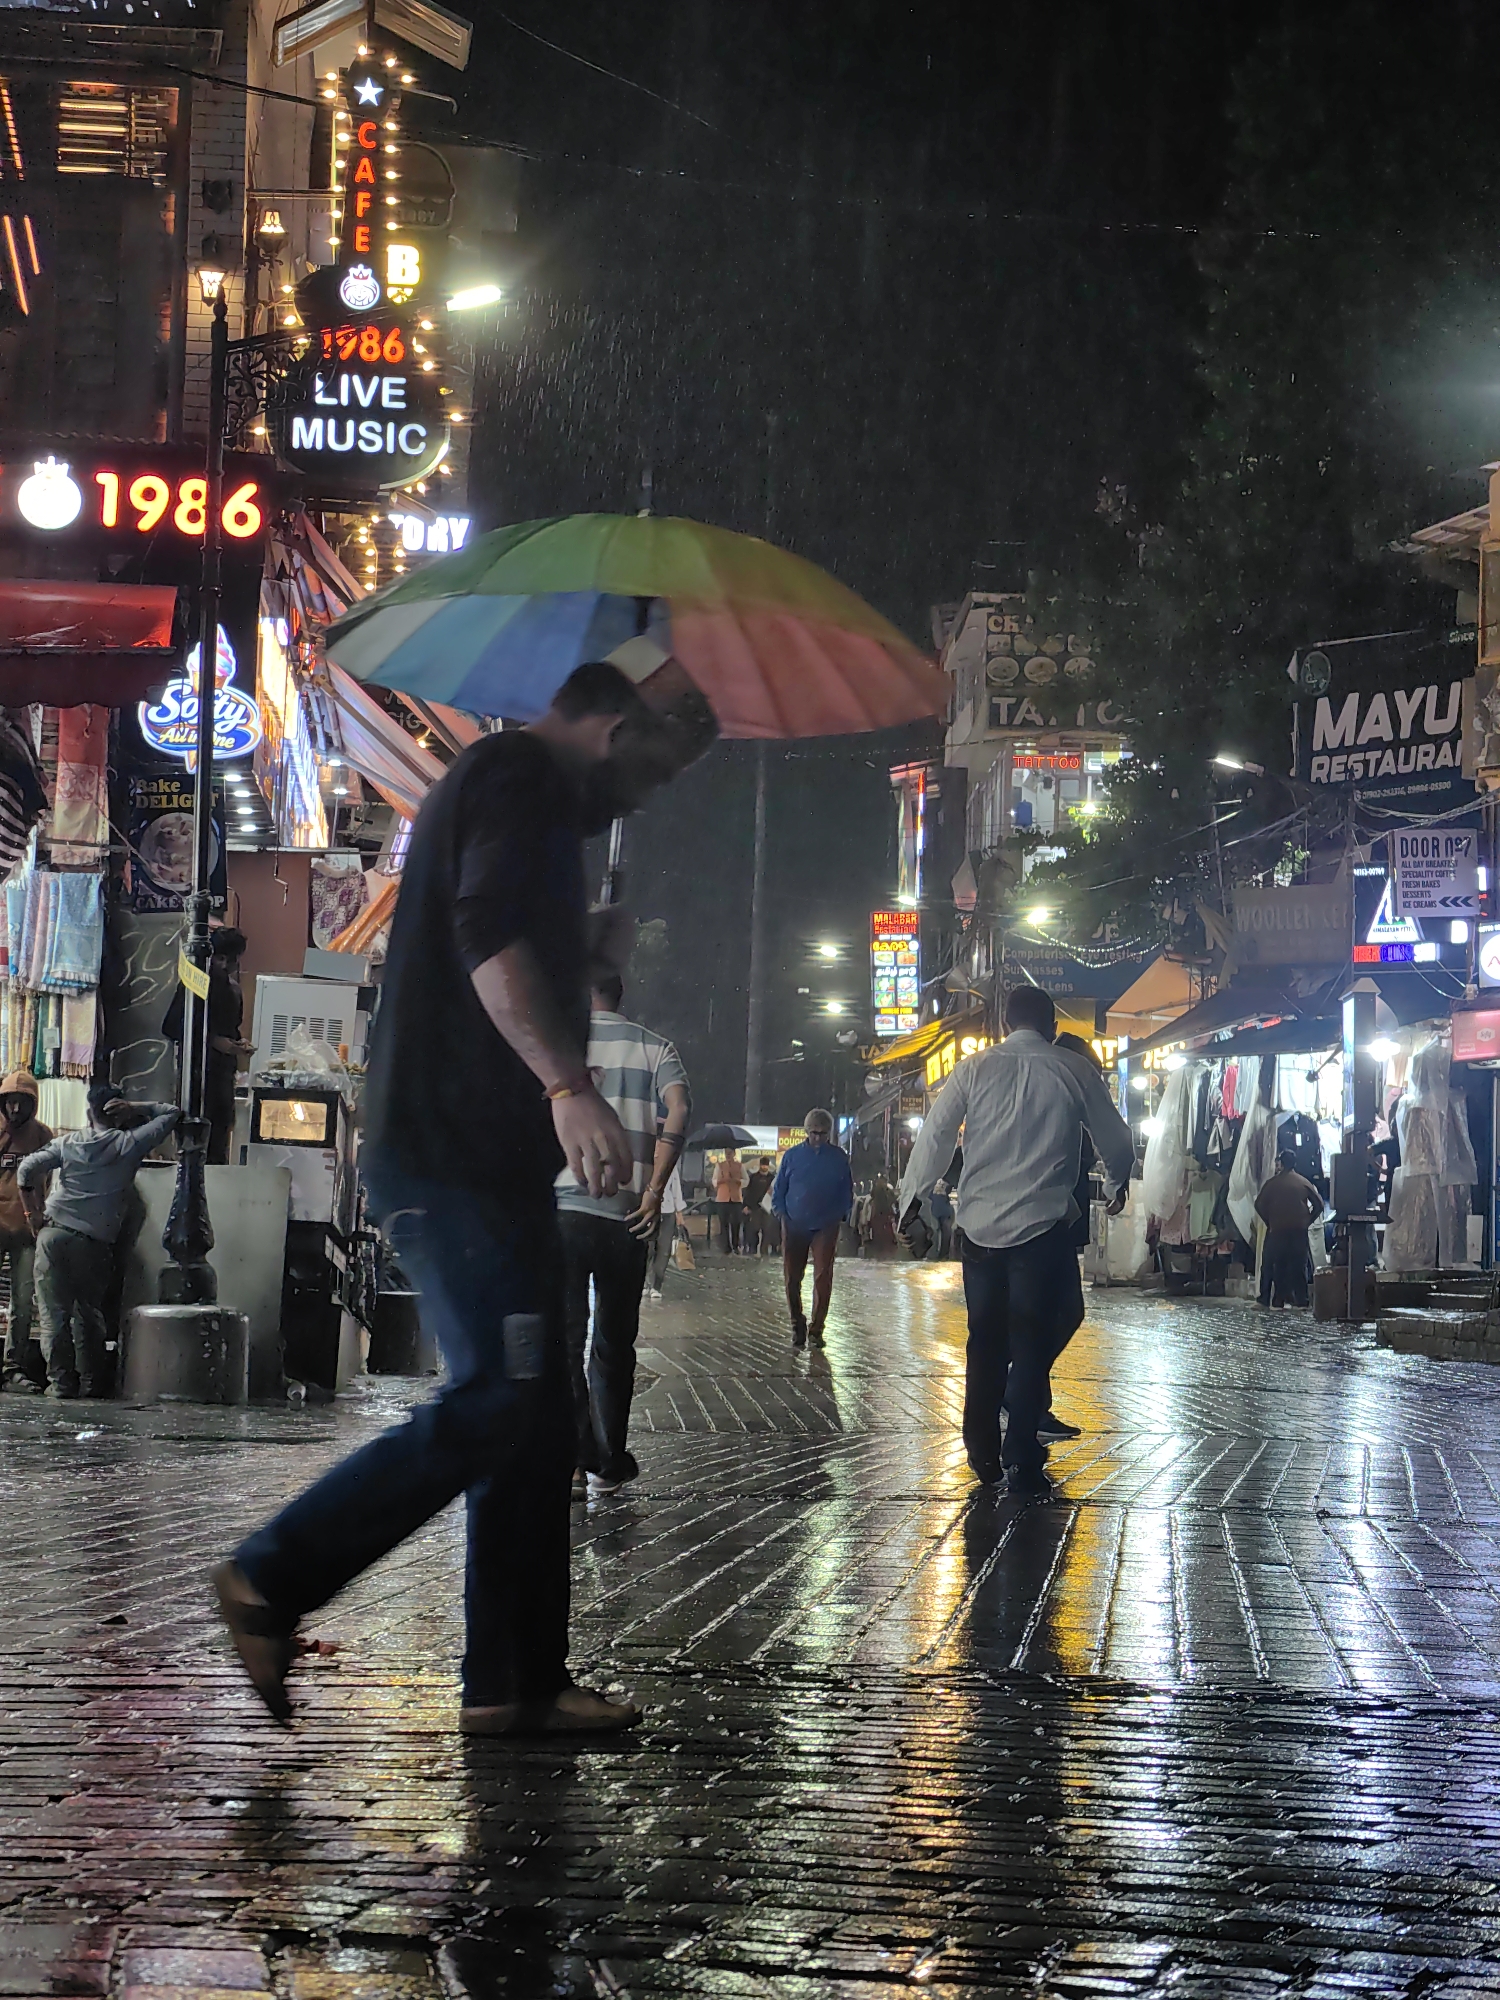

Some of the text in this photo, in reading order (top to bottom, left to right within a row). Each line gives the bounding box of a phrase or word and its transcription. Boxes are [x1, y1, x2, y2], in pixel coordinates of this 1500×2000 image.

[354, 121, 377, 252] CAFE
[320, 325, 405, 363] 1986
[314, 371, 407, 409] LIVE
[291, 416, 427, 455] MUSIC
[94, 471, 262, 539] 1986
[1312, 681, 1462, 751] MAYU
[1012, 756, 1080, 769] TATTOO
[136, 779, 181, 793] Bake
[136, 793, 219, 809] DELIGT
[1400, 836, 1440, 858] DOOR
[1401, 860, 1411, 869] ALL
[1413, 860, 1424, 869] DAY
[1401, 870, 1435, 879] SPECIALITY
[1402, 880, 1441, 889] FRESH BAKES
[1402, 890, 1432, 898] DESSERTS
[136, 896, 180, 909] CAKE
[1402, 900, 1437, 909] ICE CREAMS
[873, 913, 918, 925] MALABAR
[1080, 950, 1099, 962] Eye
[1103, 949, 1143, 964] Testig
[1049, 980, 1074, 992] Lens
